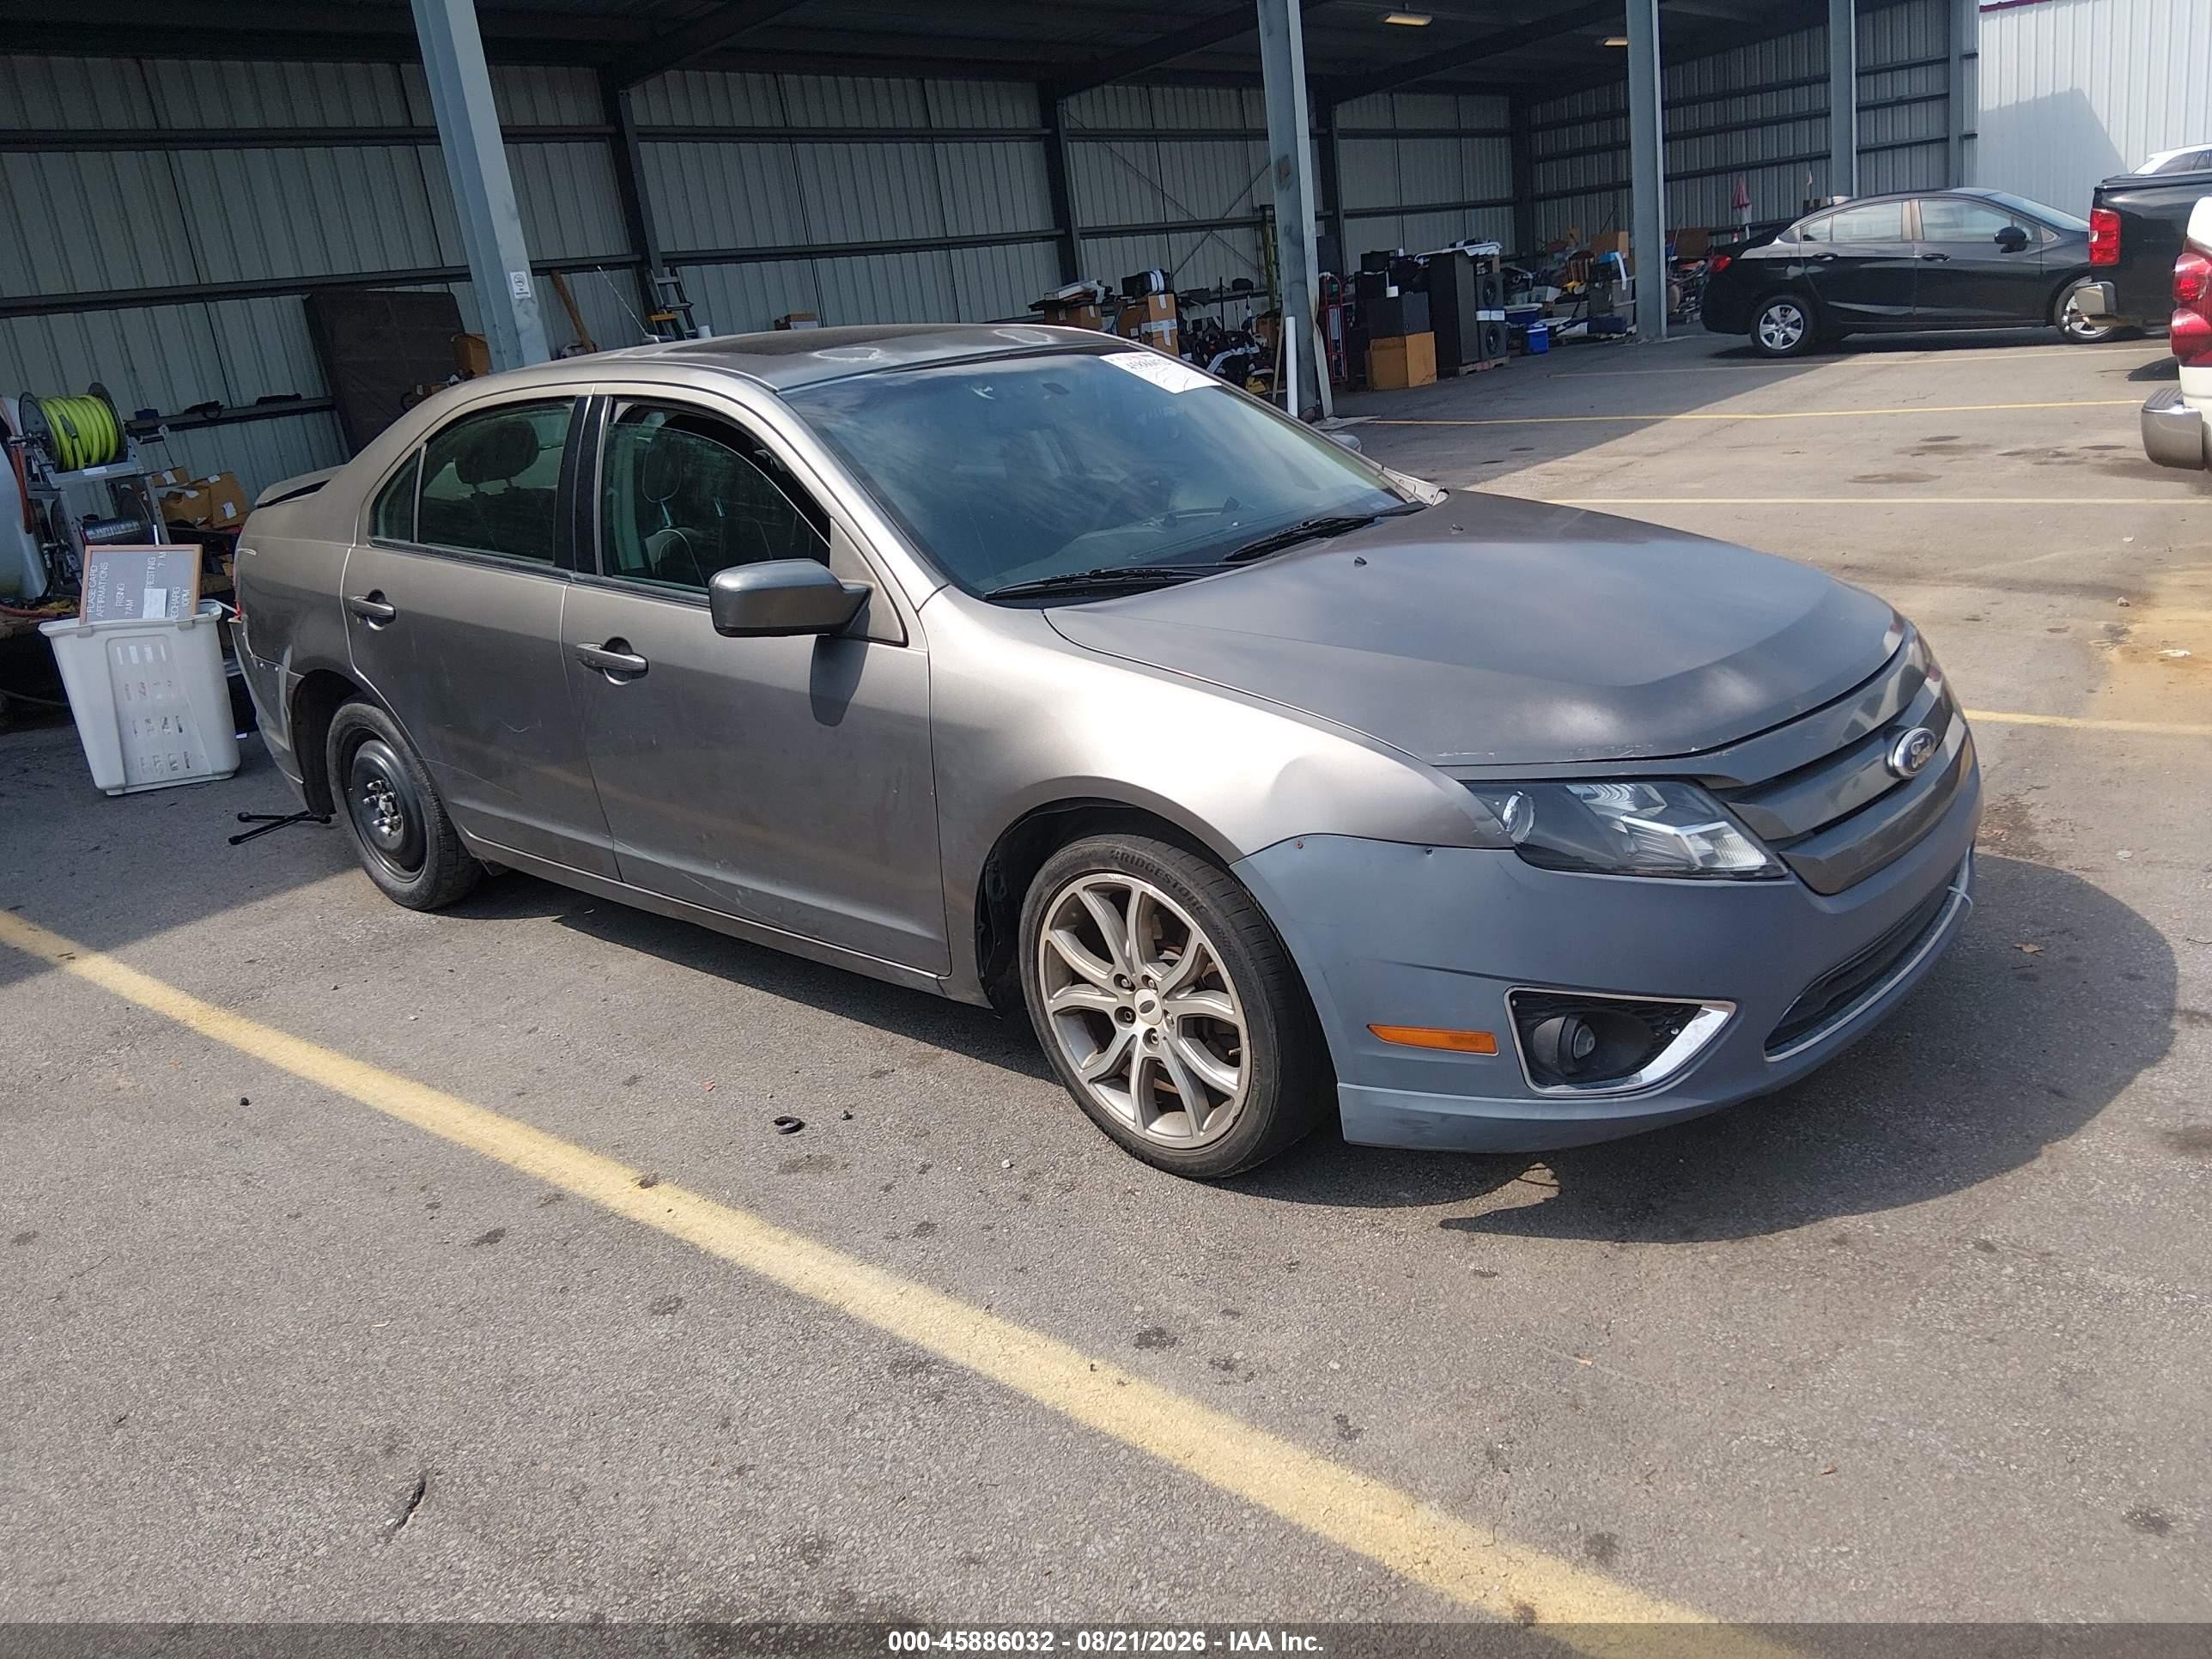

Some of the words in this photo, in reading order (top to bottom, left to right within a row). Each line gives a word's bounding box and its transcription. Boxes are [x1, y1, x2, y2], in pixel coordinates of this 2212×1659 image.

[88, 565, 98, 588] CARD
[145, 556, 156, 588] RESTING
[96, 562, 108, 617] AFFIRMATIONS
[116, 583, 125, 608] RISING
[125, 599, 135, 616] 7AM
[1109, 849, 1209, 914] BRIDGESTONE
